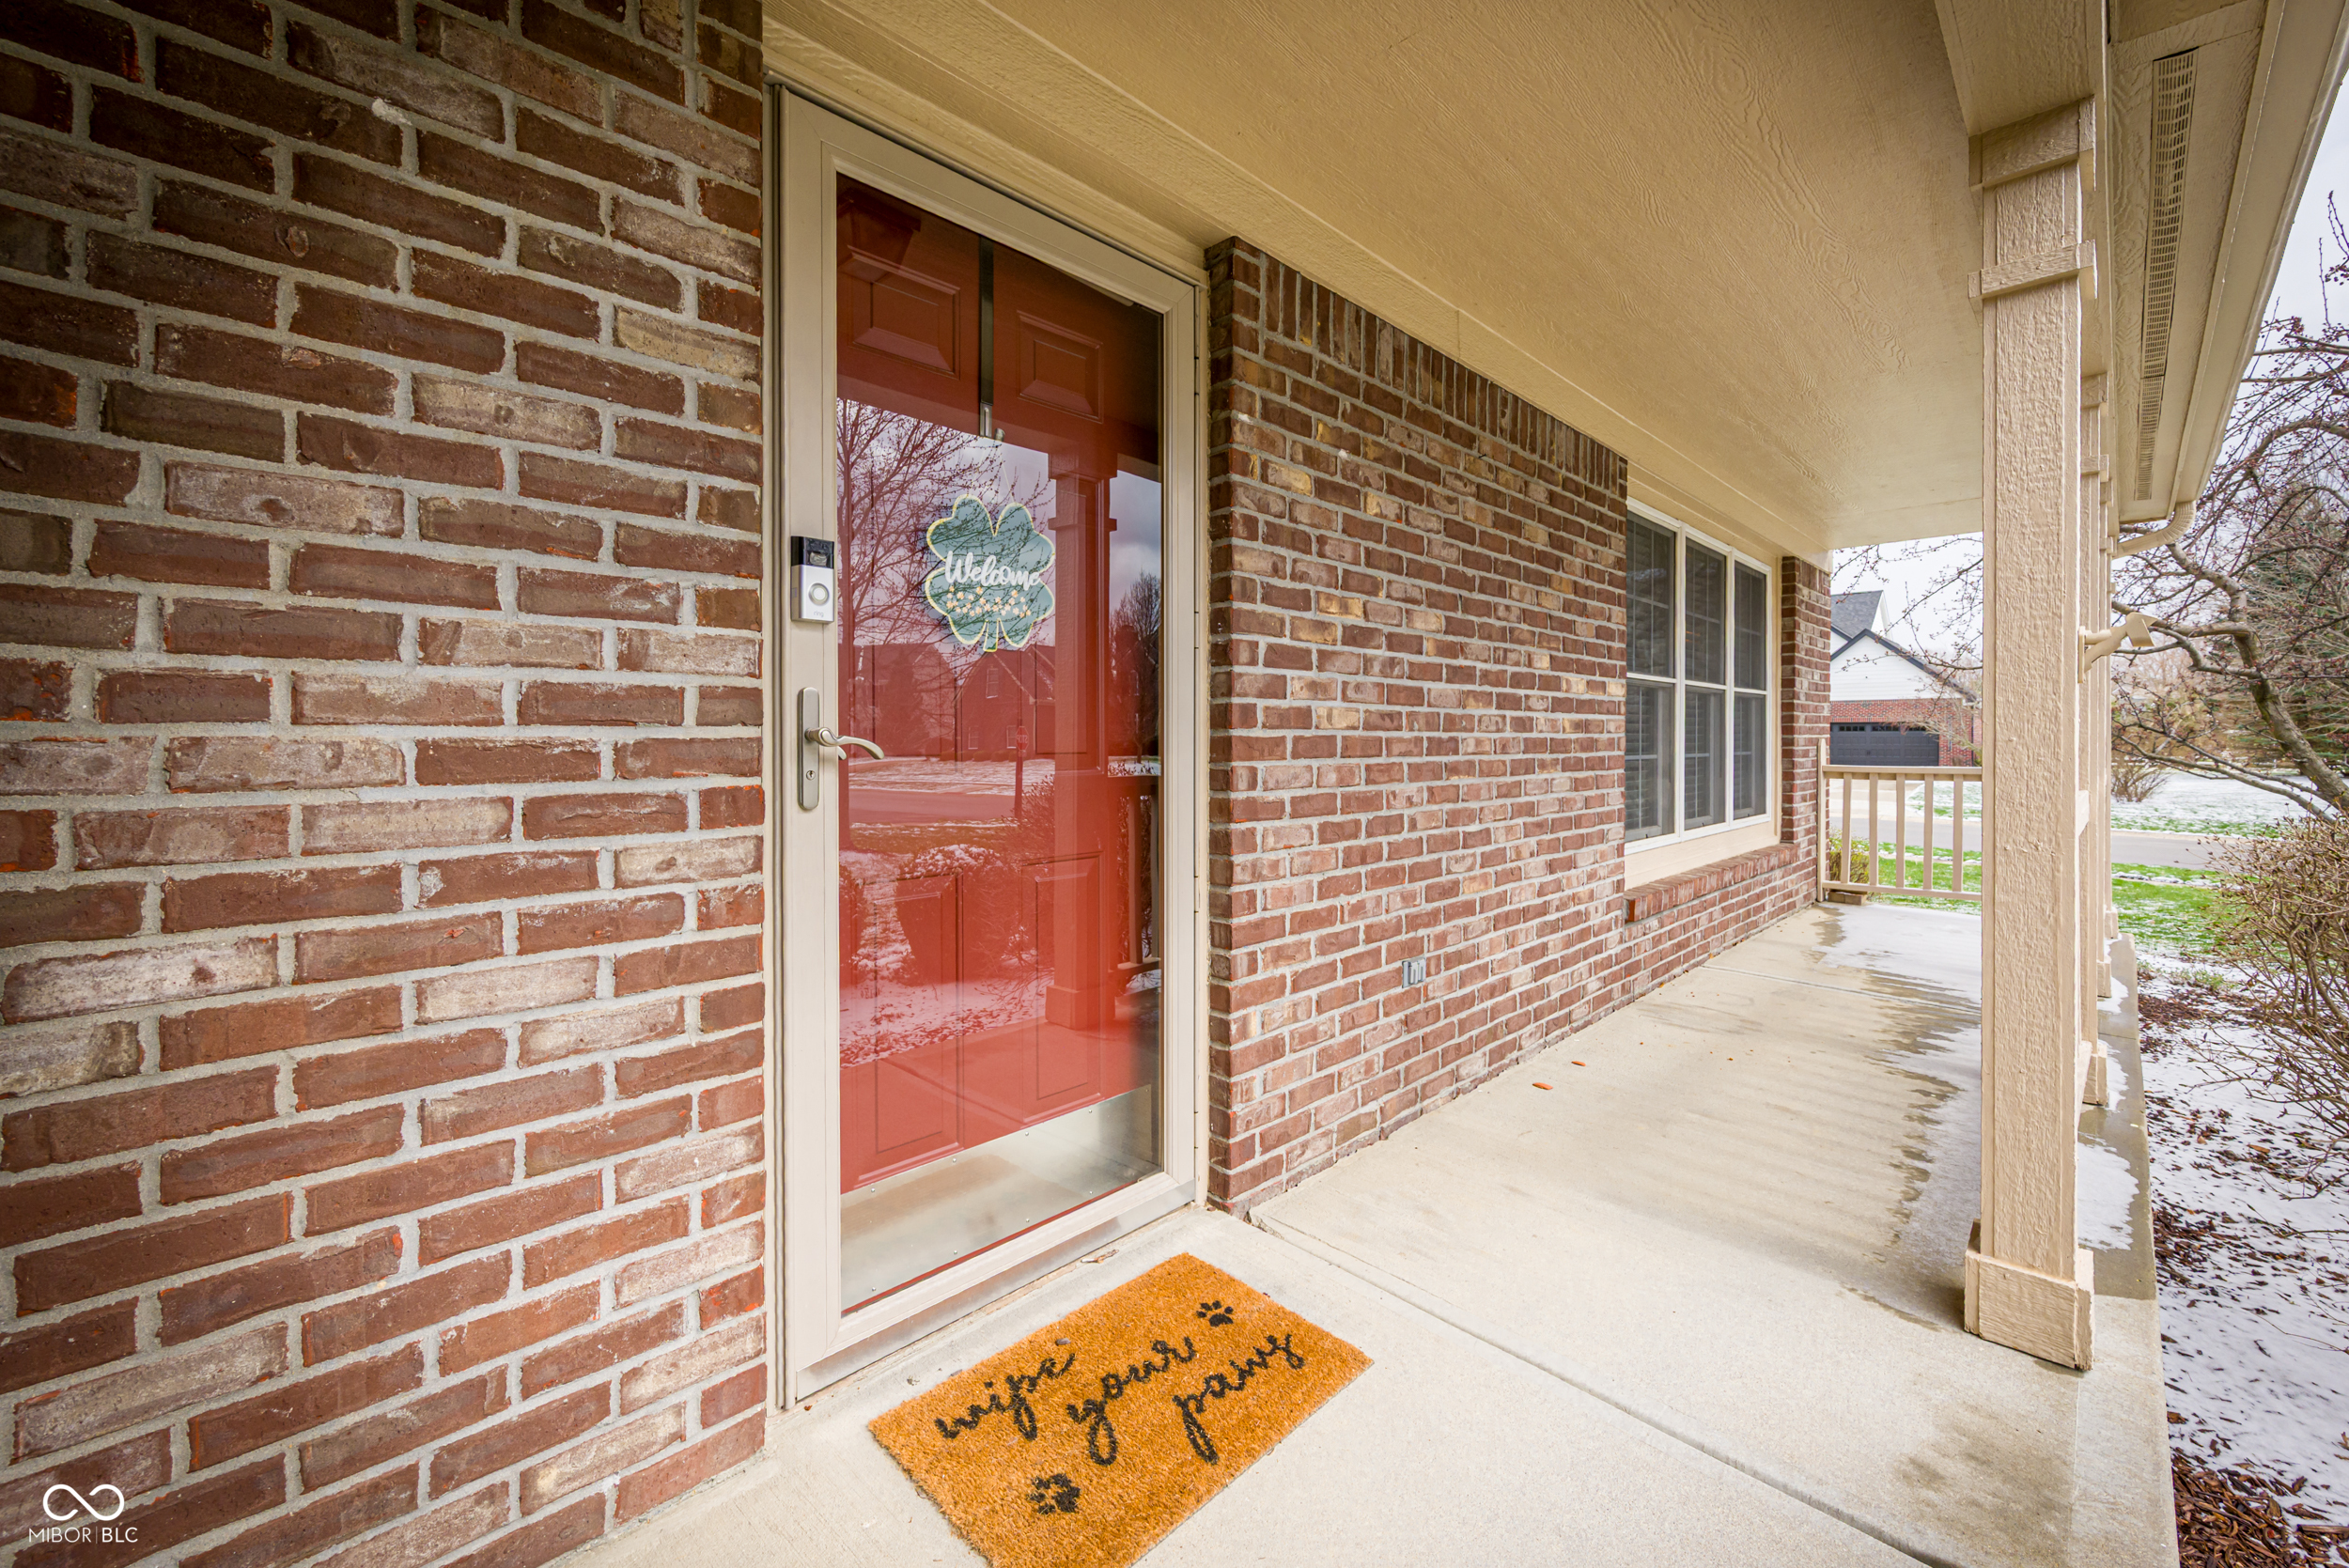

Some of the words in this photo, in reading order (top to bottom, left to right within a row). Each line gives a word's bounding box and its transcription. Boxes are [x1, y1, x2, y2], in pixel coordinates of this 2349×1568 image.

[944, 551, 1042, 591] Welcome
[934, 1352, 1076, 1441] wipe
[1066, 1336, 1198, 1467] your
[1173, 1332, 1305, 1466] paws
